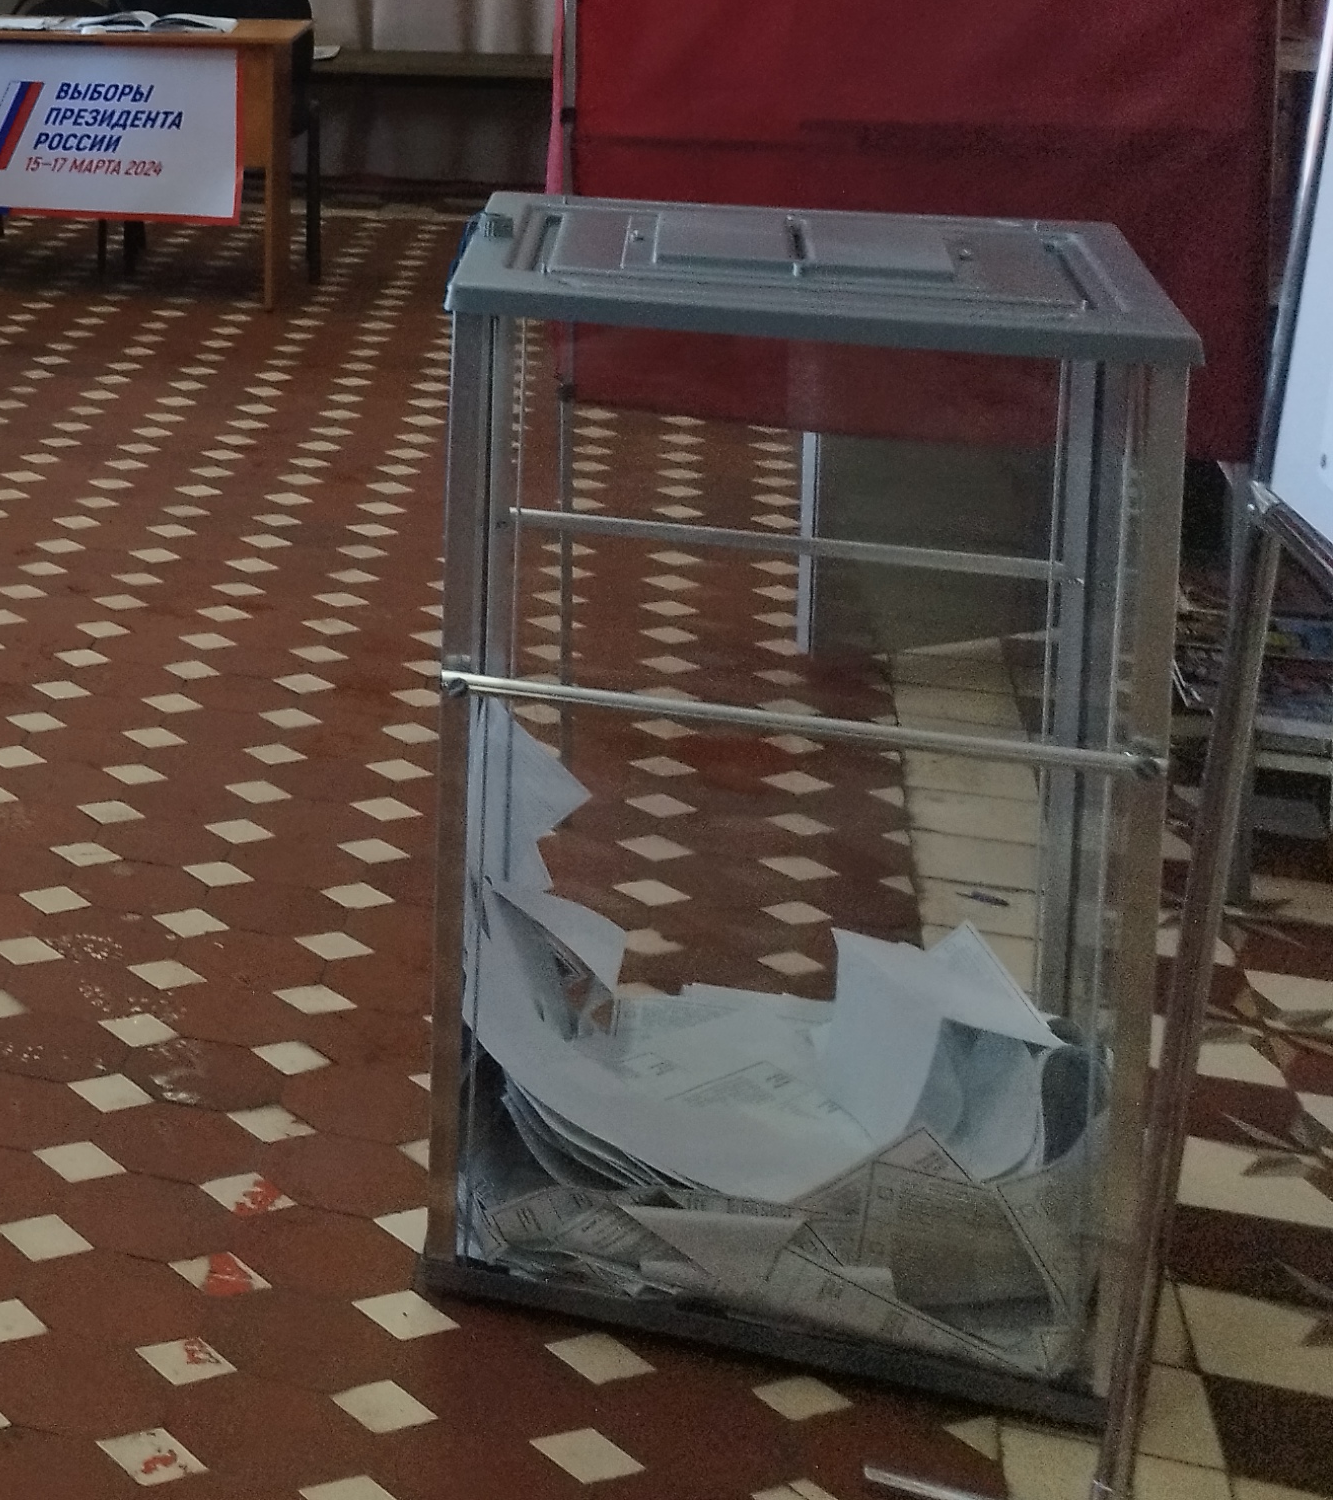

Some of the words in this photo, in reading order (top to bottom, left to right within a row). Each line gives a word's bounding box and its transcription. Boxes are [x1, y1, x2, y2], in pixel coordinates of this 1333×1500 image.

[55, 82, 154, 103] ВЫБОРЫ
[43, 107, 183, 131] ПРЕЗИДЕНТА
[33, 132, 123, 153] РОССИИ
[68, 158, 122, 176] МАРТА
[124, 160, 164, 177] 2024
